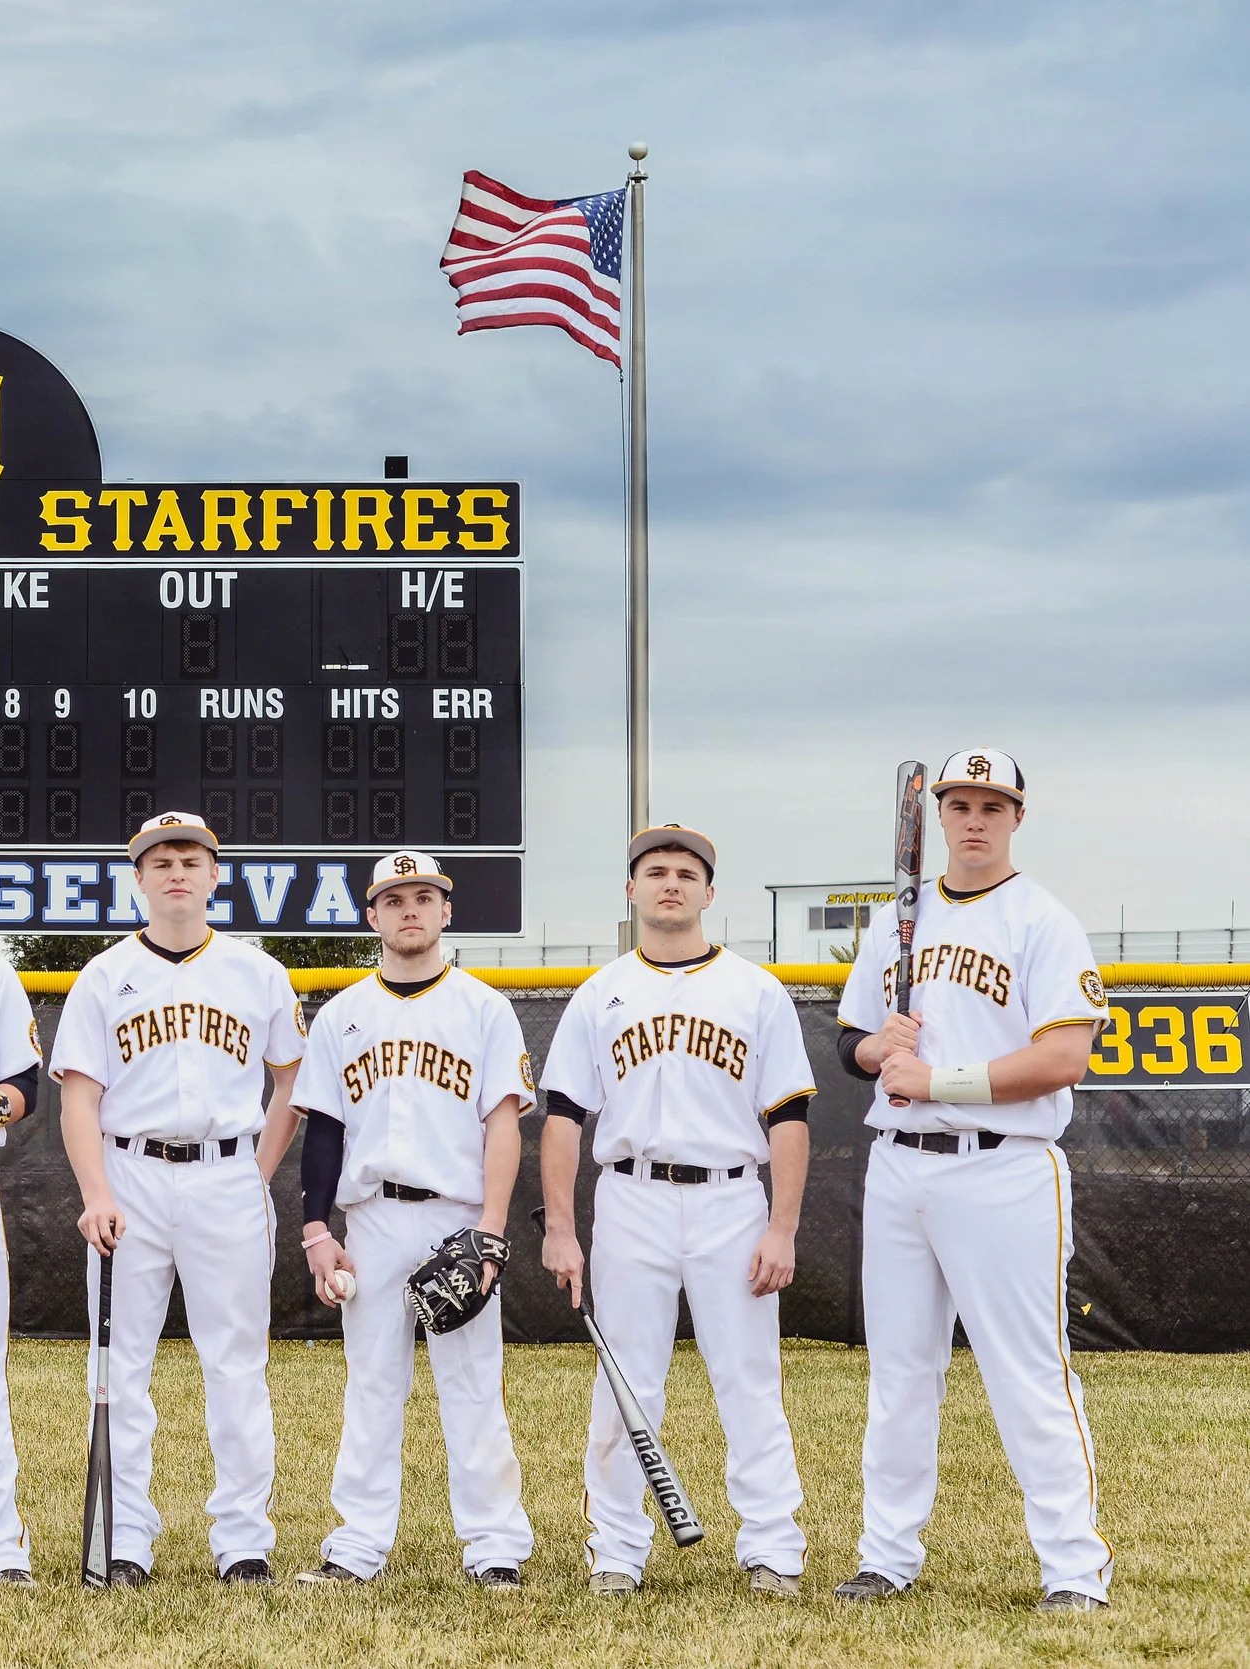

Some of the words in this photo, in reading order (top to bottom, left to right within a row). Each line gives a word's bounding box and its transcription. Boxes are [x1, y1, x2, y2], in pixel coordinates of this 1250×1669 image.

[39, 488, 510, 552] STARFIRES
[158, 570, 239, 609] OUT
[400, 570, 465, 612] H/E
[4, 689, 21, 719] 8
[54, 689, 71, 719] 9
[123, 689, 157, 719] 10
[200, 688, 284, 719] RUNS
[331, 688, 400, 719] HITS
[432, 689, 494, 719] ERR
[115, 1002, 251, 1067] STARFIRES
[611, 1013, 748, 1082] STARFIRES
[1088, 1006, 1243, 1075] 336
[342, 1039, 473, 1104] STARFIRES
[631, 1428, 699, 1532] marucci
[93, 1521, 102, 1570] ELITE
